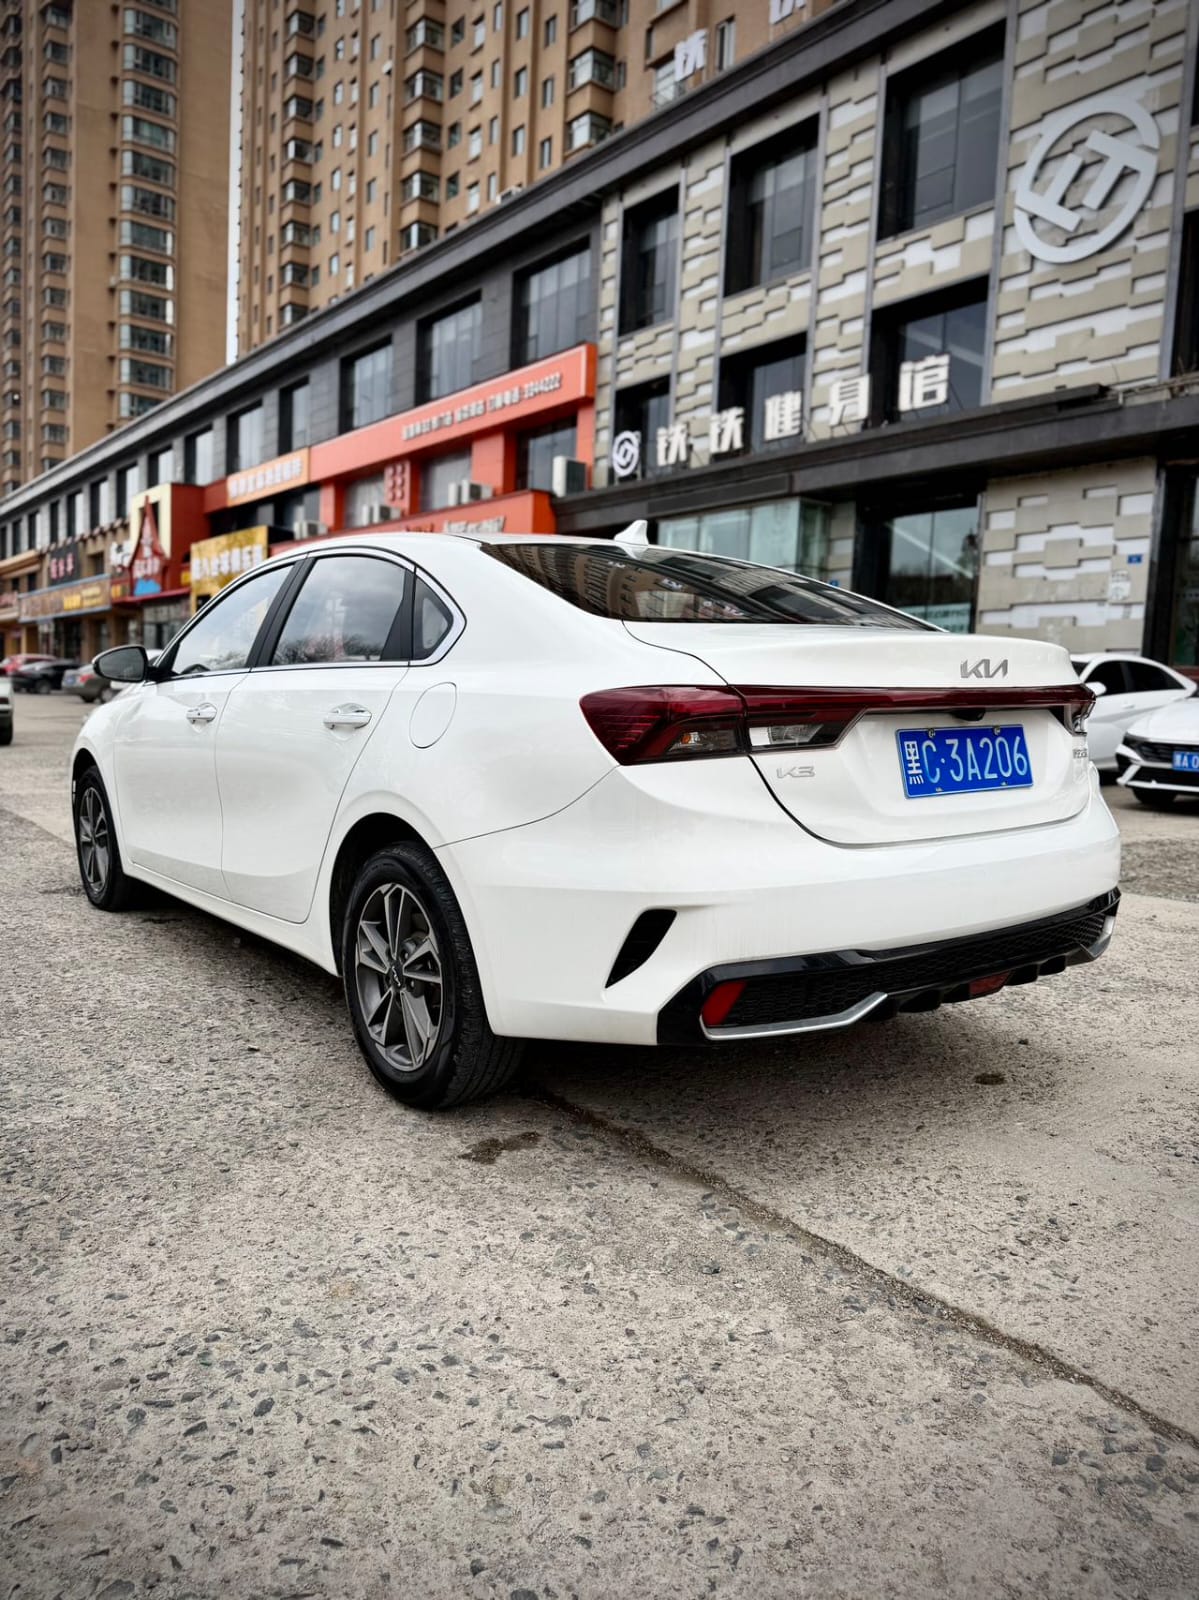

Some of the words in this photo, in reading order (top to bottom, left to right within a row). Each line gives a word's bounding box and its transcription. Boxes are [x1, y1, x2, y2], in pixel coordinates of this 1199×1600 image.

[656, 353, 951, 467] 铁铁健身馆
[961, 659, 1008, 679] KIA
[776, 766, 816, 779] K3
